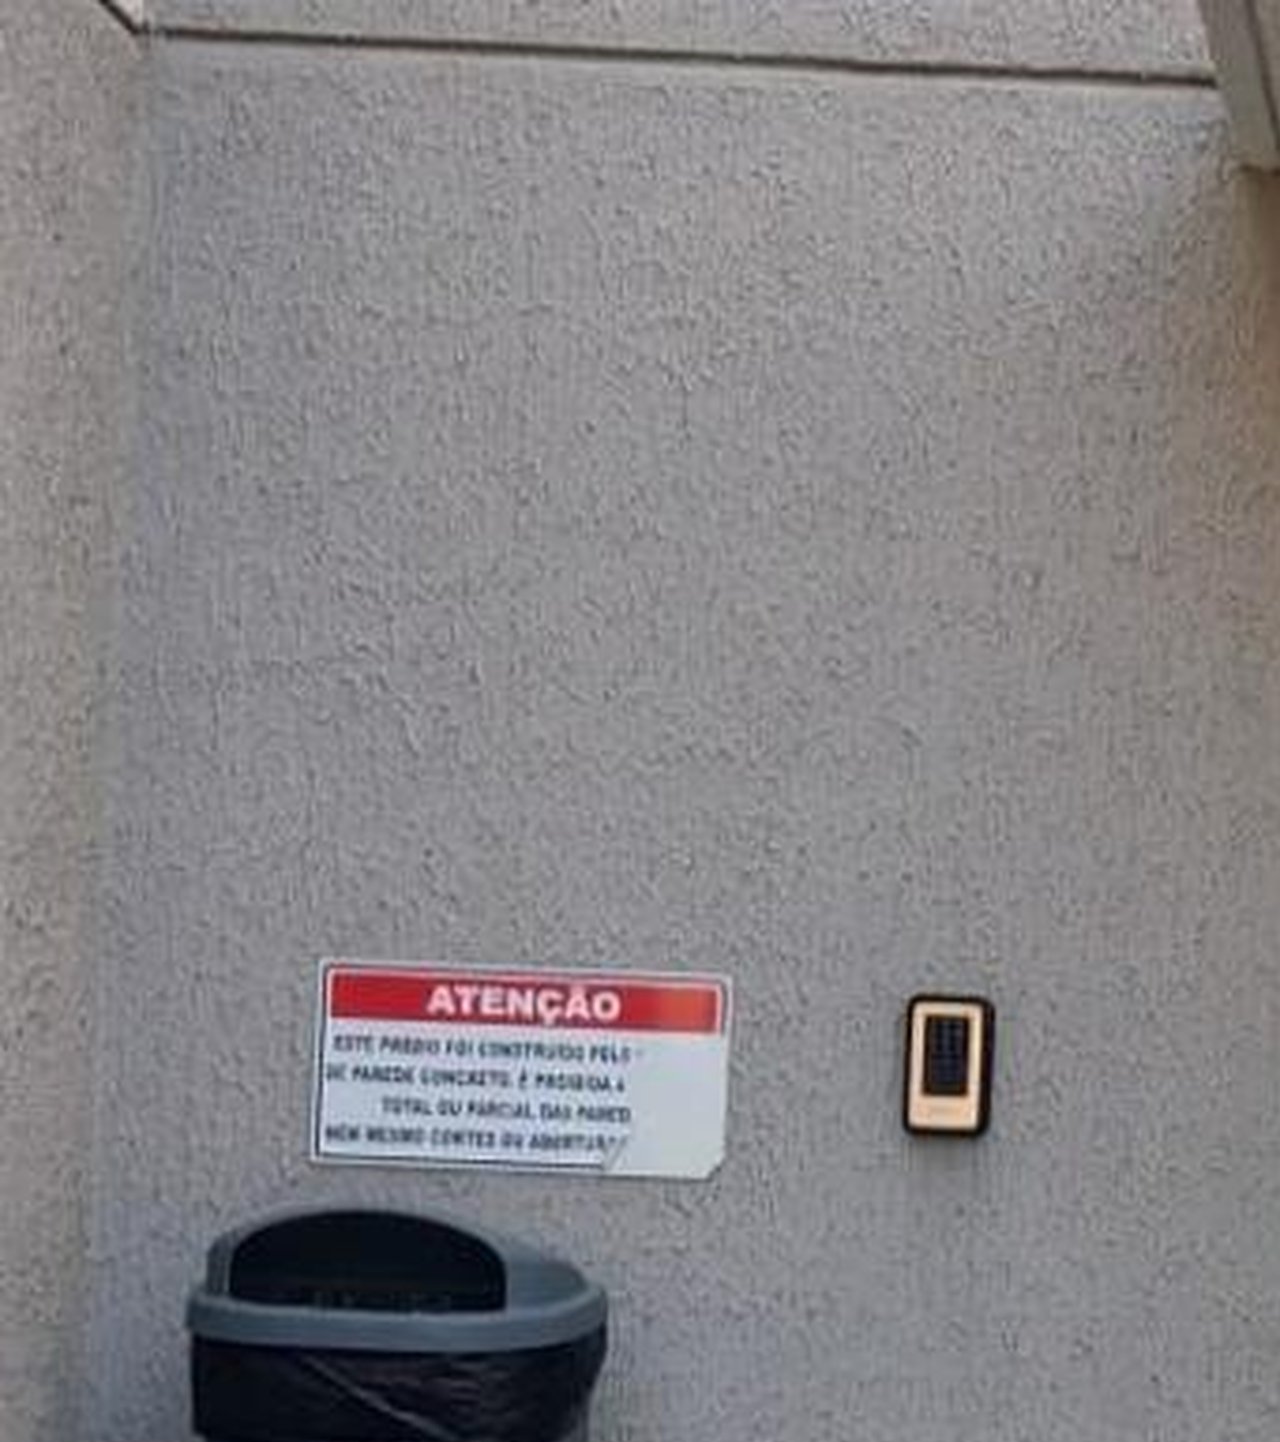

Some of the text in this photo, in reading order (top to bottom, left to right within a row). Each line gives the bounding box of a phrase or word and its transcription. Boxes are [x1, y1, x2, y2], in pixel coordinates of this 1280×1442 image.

[428, 984, 621, 1025] ATENÇÃO
[382, 1096, 434, 1116] TOTAL
[436, 1098, 463, 1117] OU
